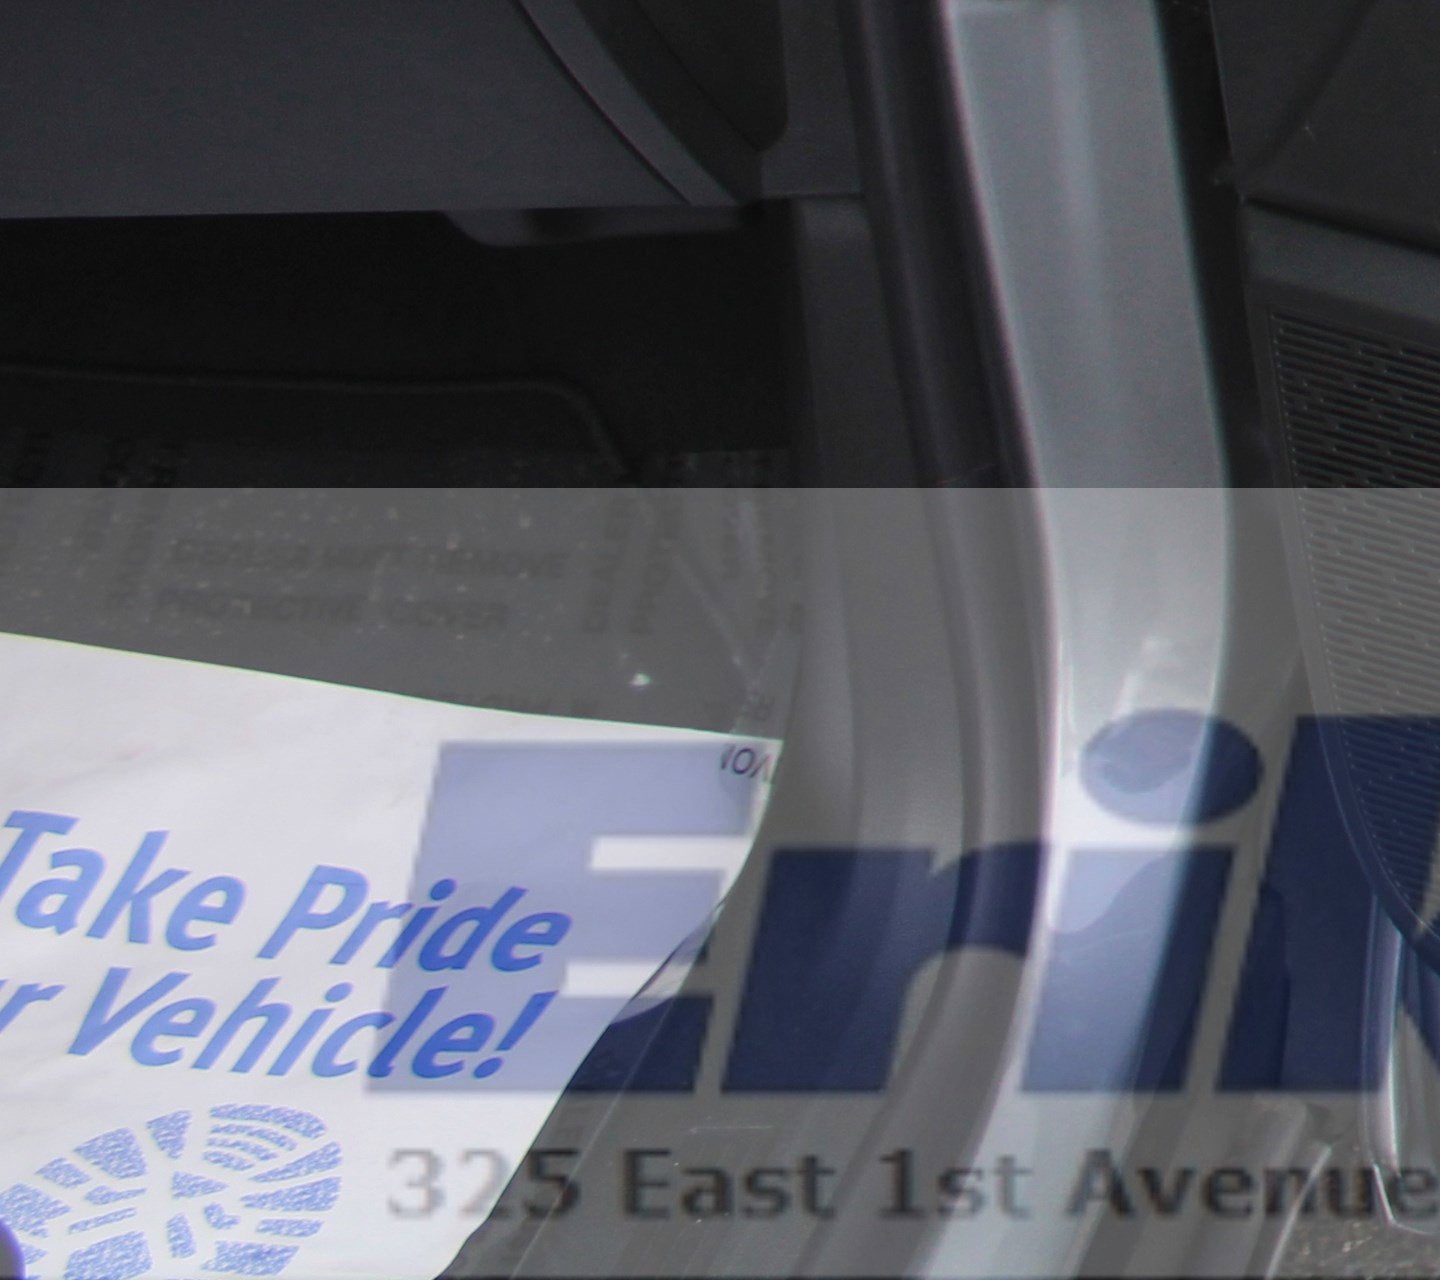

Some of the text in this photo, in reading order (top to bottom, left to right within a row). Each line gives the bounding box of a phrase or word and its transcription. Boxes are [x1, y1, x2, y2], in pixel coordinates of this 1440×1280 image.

[0, 809, 574, 973] Take Pride
[67, 966, 561, 1080] Vehicle!
